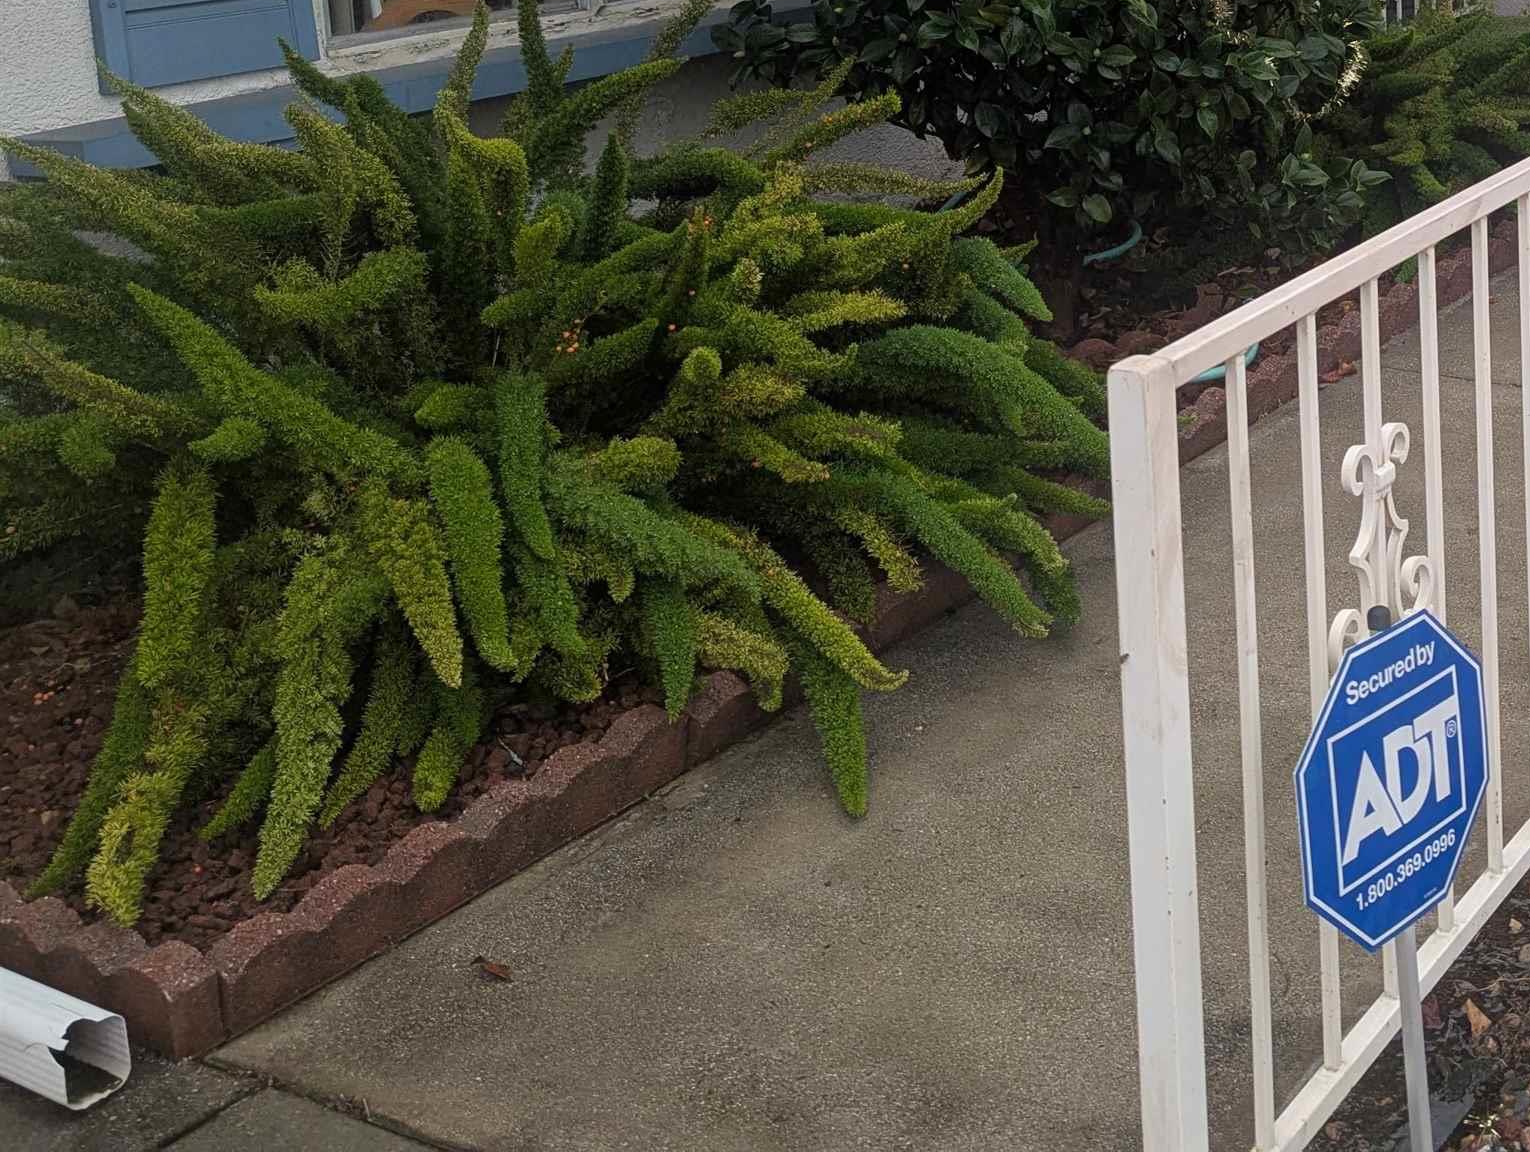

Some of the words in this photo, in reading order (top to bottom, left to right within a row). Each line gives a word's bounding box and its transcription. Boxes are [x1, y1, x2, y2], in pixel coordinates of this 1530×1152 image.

[1345, 648, 1416, 705] Secured
[1416, 641, 1436, 666] by
[1355, 828, 1457, 911] 1.800.369.0996
